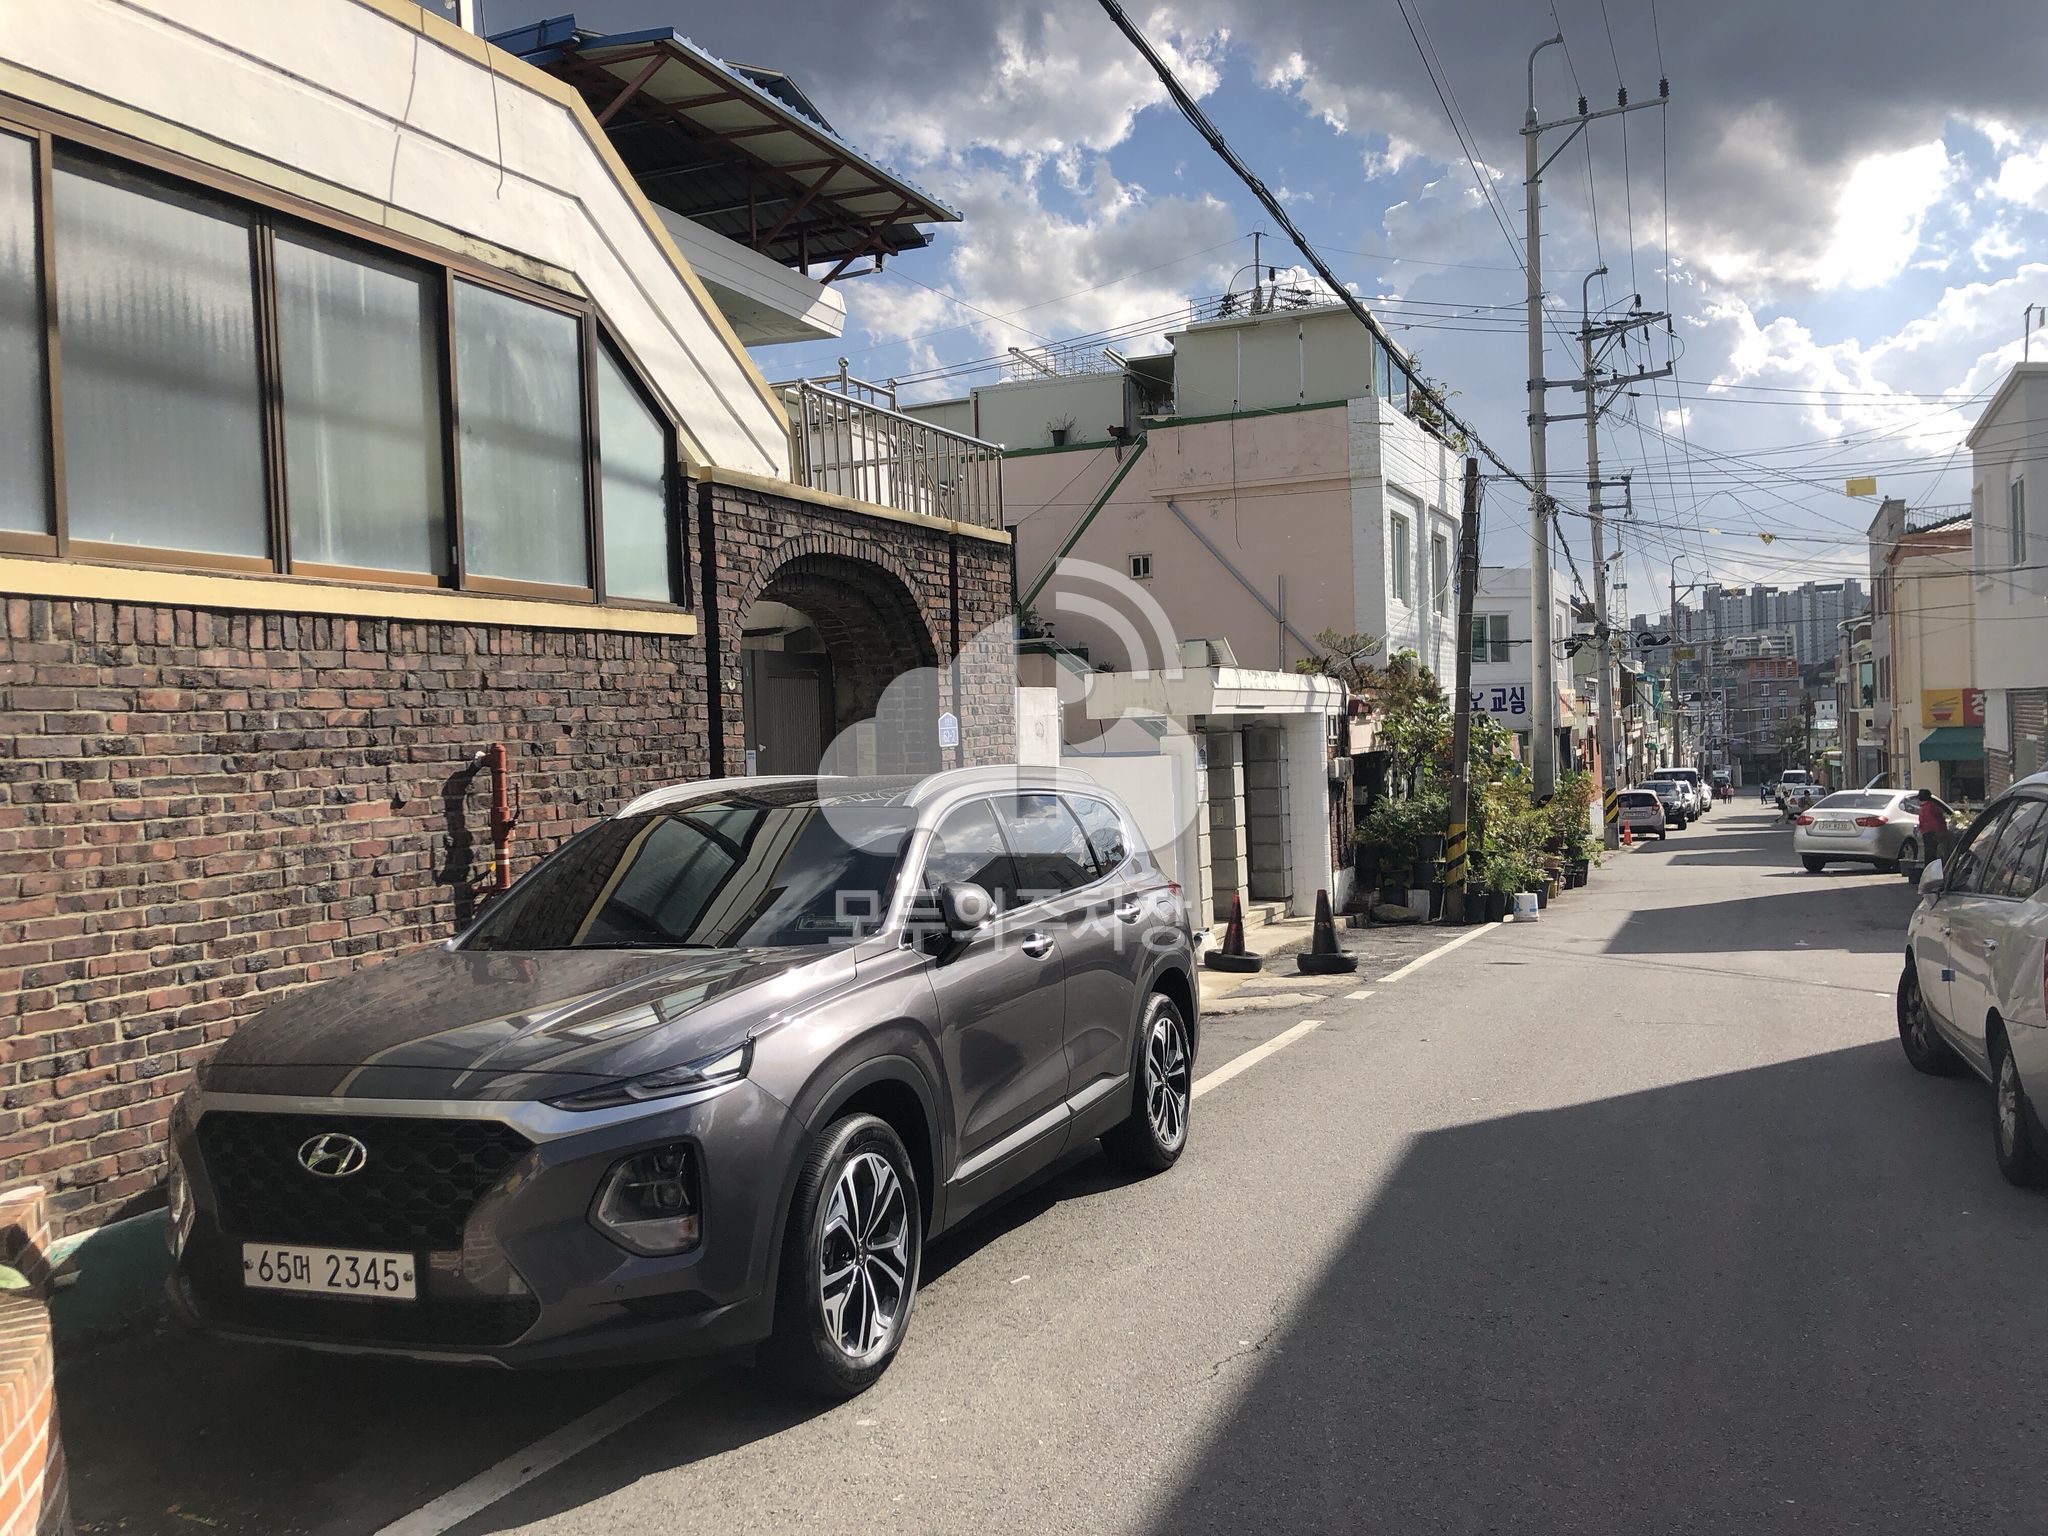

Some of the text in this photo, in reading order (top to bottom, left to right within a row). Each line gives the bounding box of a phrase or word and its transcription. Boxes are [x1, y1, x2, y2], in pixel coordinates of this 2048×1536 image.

[1489, 686, 1527, 714] 교실
[258, 1250, 399, 1291] 65머 2345
